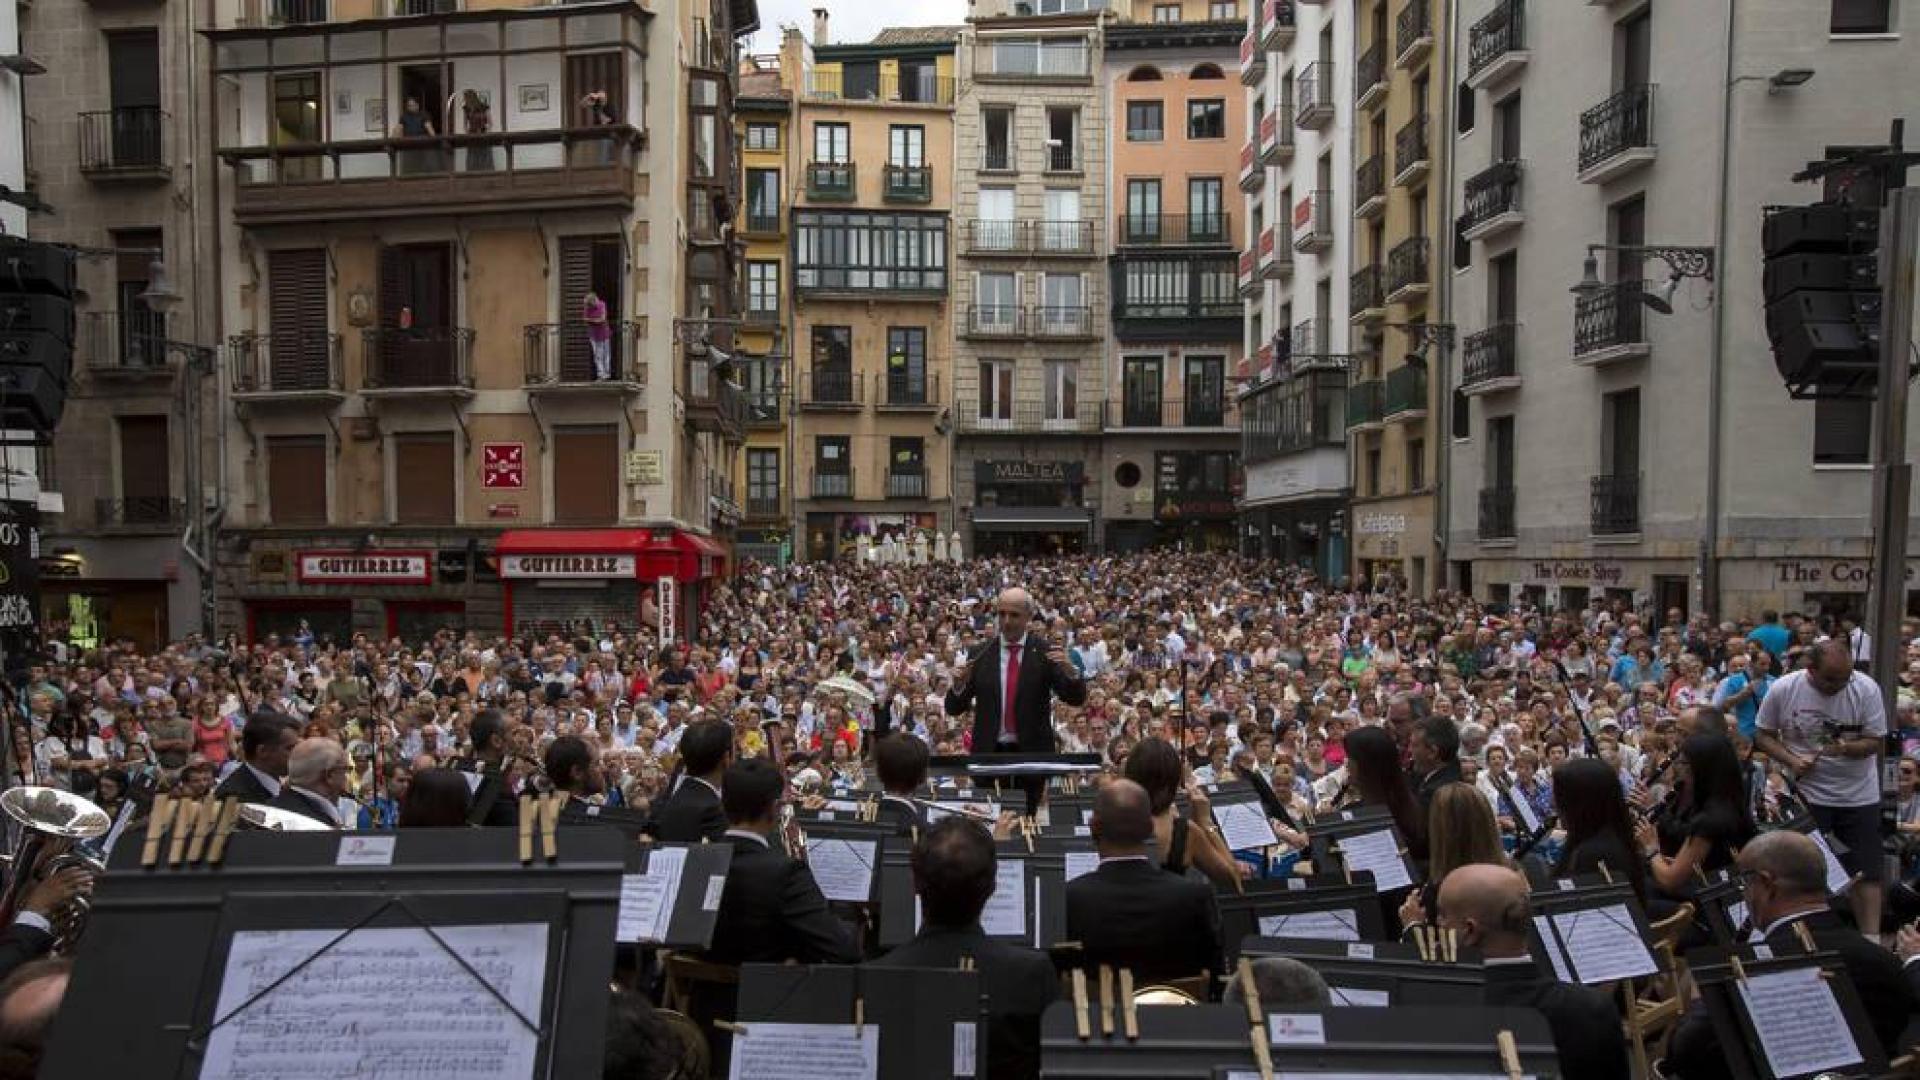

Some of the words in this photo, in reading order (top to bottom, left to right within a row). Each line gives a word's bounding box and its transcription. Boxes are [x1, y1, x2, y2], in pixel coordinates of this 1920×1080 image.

[318, 559, 410, 573] GUTIERREZ
[519, 557, 618, 573] GUTIERREZ
[1534, 561, 1552, 579] The
[1554, 561, 1590, 579] Cookie
[1775, 561, 1821, 582] The
